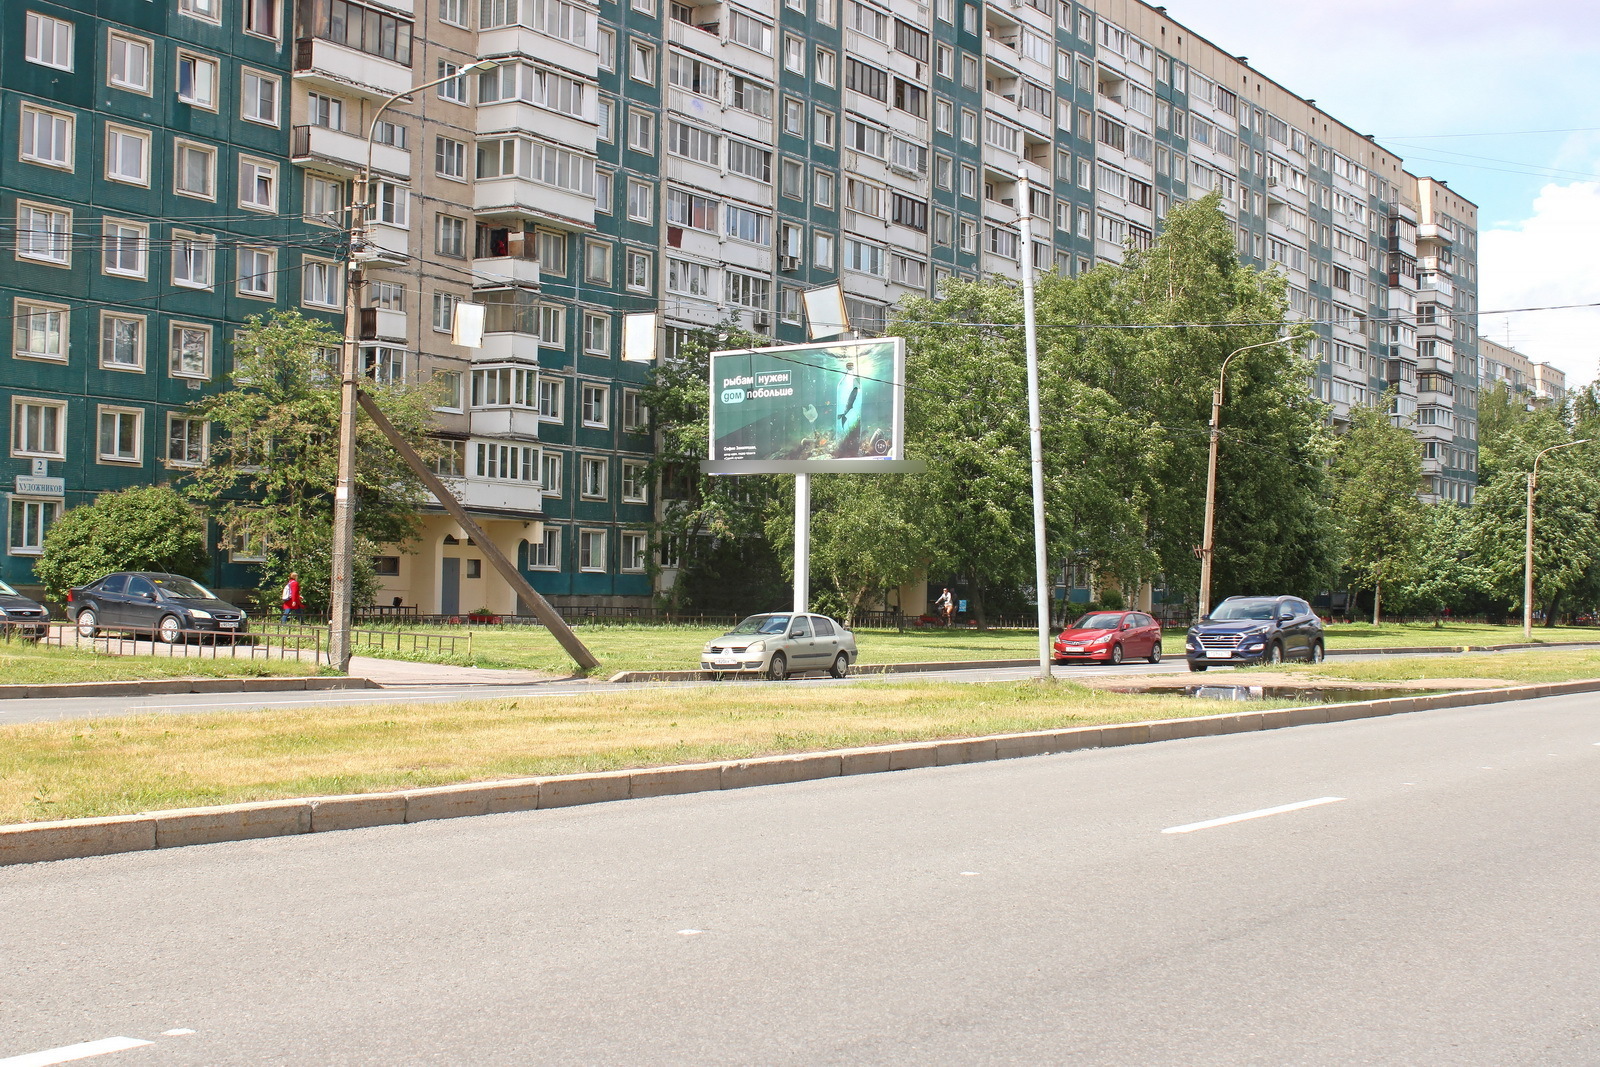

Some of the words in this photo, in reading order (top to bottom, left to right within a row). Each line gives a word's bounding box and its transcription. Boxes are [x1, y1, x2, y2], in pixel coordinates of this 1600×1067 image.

[723, 375, 754, 388] рыбам
[758, 373, 789, 386] нужен
[723, 391, 742, 402] дом
[746, 387, 794, 399] побольше
[38, 460, 42, 470] 2
[18, 483, 62, 492] ХУДОЖНИКОВ
